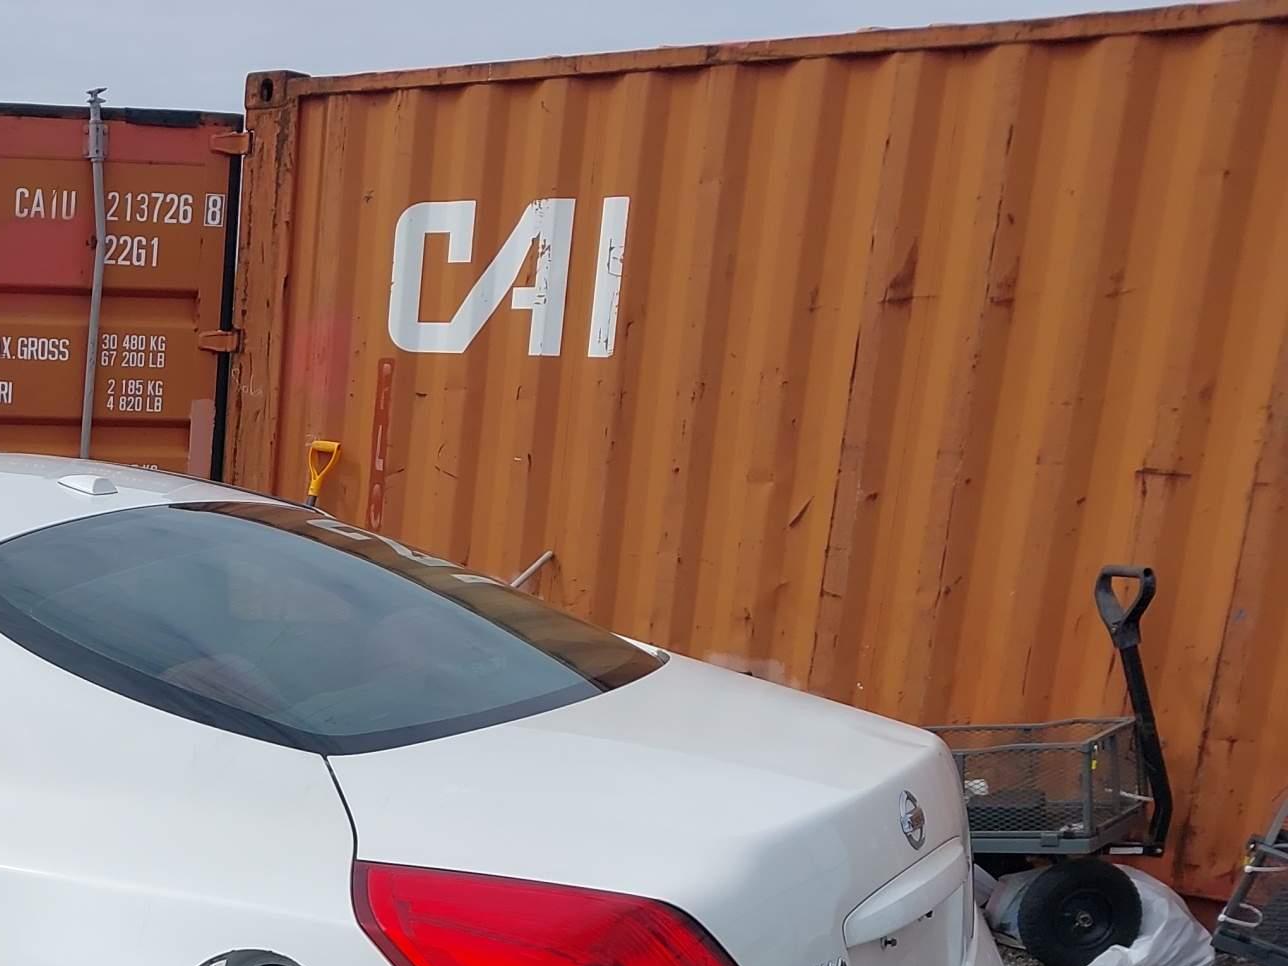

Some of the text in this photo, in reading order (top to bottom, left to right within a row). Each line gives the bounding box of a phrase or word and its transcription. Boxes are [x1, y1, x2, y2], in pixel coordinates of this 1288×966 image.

[106, 191, 193, 224] 213726
[207, 195, 222, 225] 8
[104, 235, 159, 267] 22G1
[388, 196, 630, 357] CAI
[102, 334, 117, 350] 30
[123, 335, 146, 350] 480
[150, 335, 166, 351] KG
[101, 351, 165, 368] 67 200 LB
[107, 379, 115, 394] 2
[122, 379, 144, 395] 185
[147, 380, 163, 396] KG
[106, 395, 162, 413] 4 820 LB
